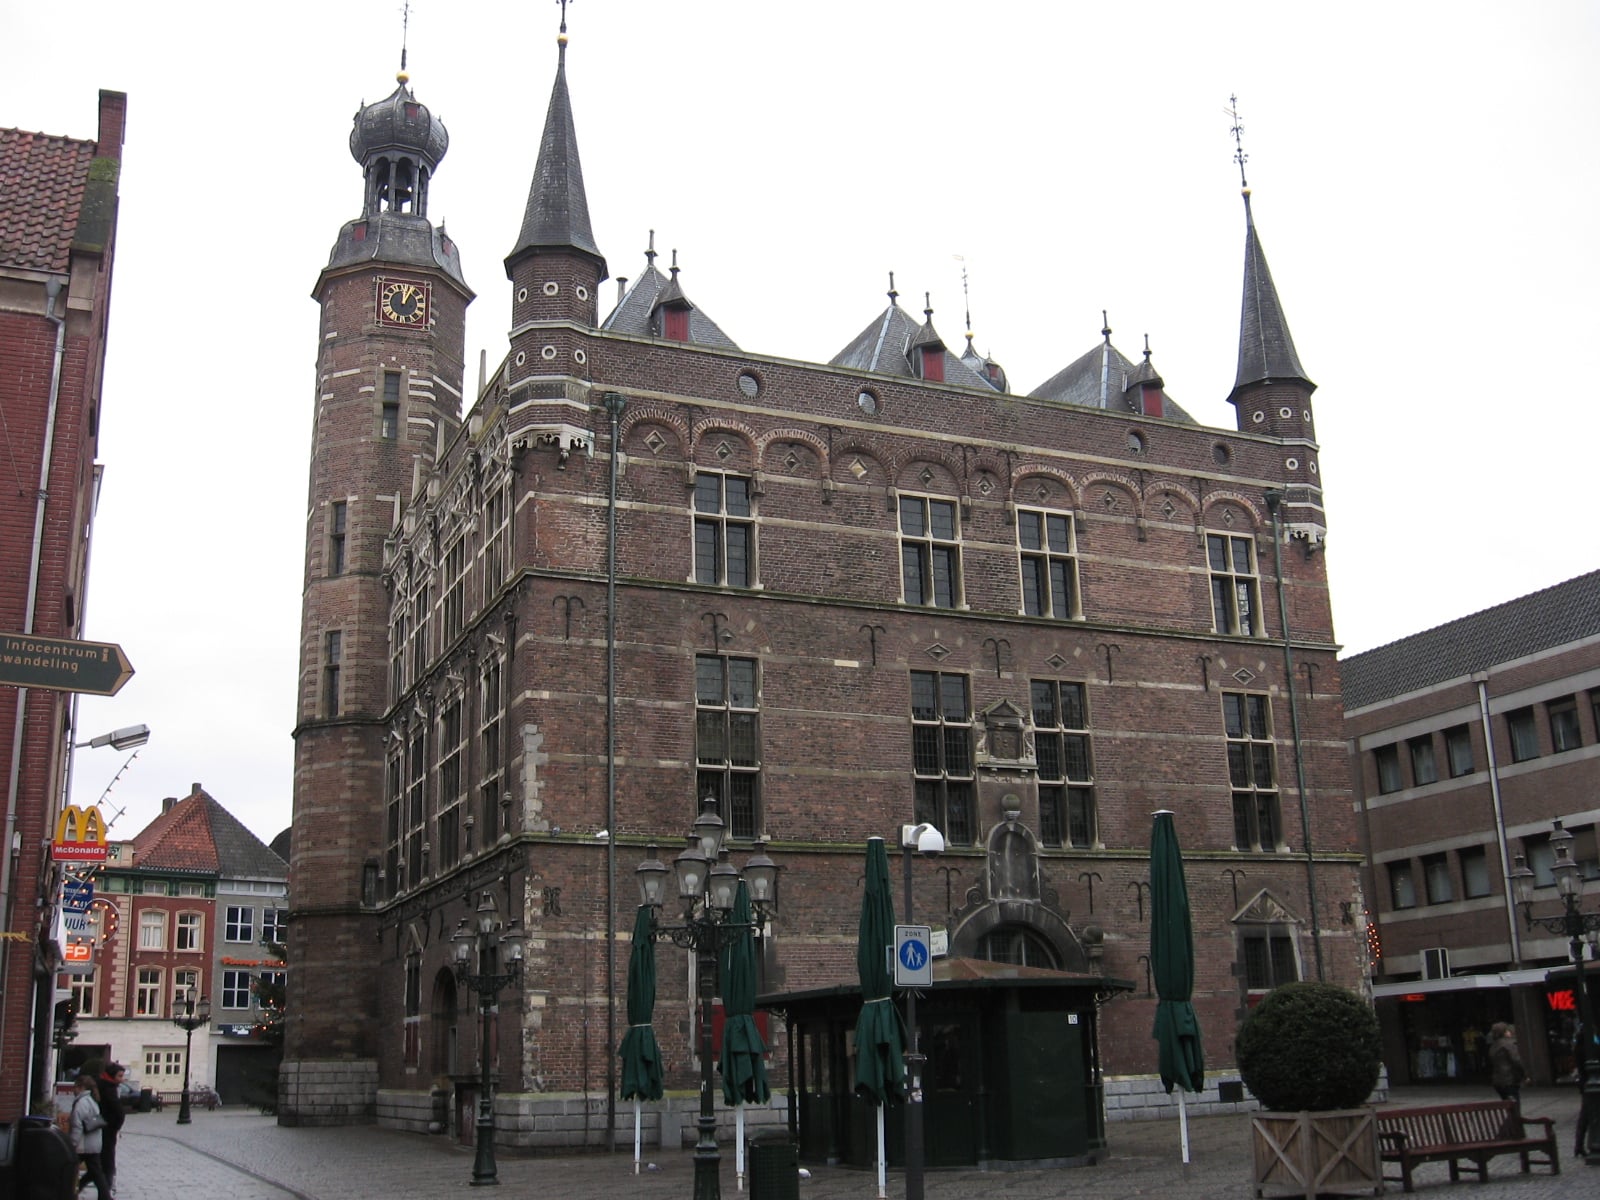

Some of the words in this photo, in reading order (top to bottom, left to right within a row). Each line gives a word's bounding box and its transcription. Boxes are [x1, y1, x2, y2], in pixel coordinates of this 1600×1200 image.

[6, 639, 97, 659] Infocentrum
[0, 653, 79, 673] wandeling
[55, 846, 106, 854] McDonald's
